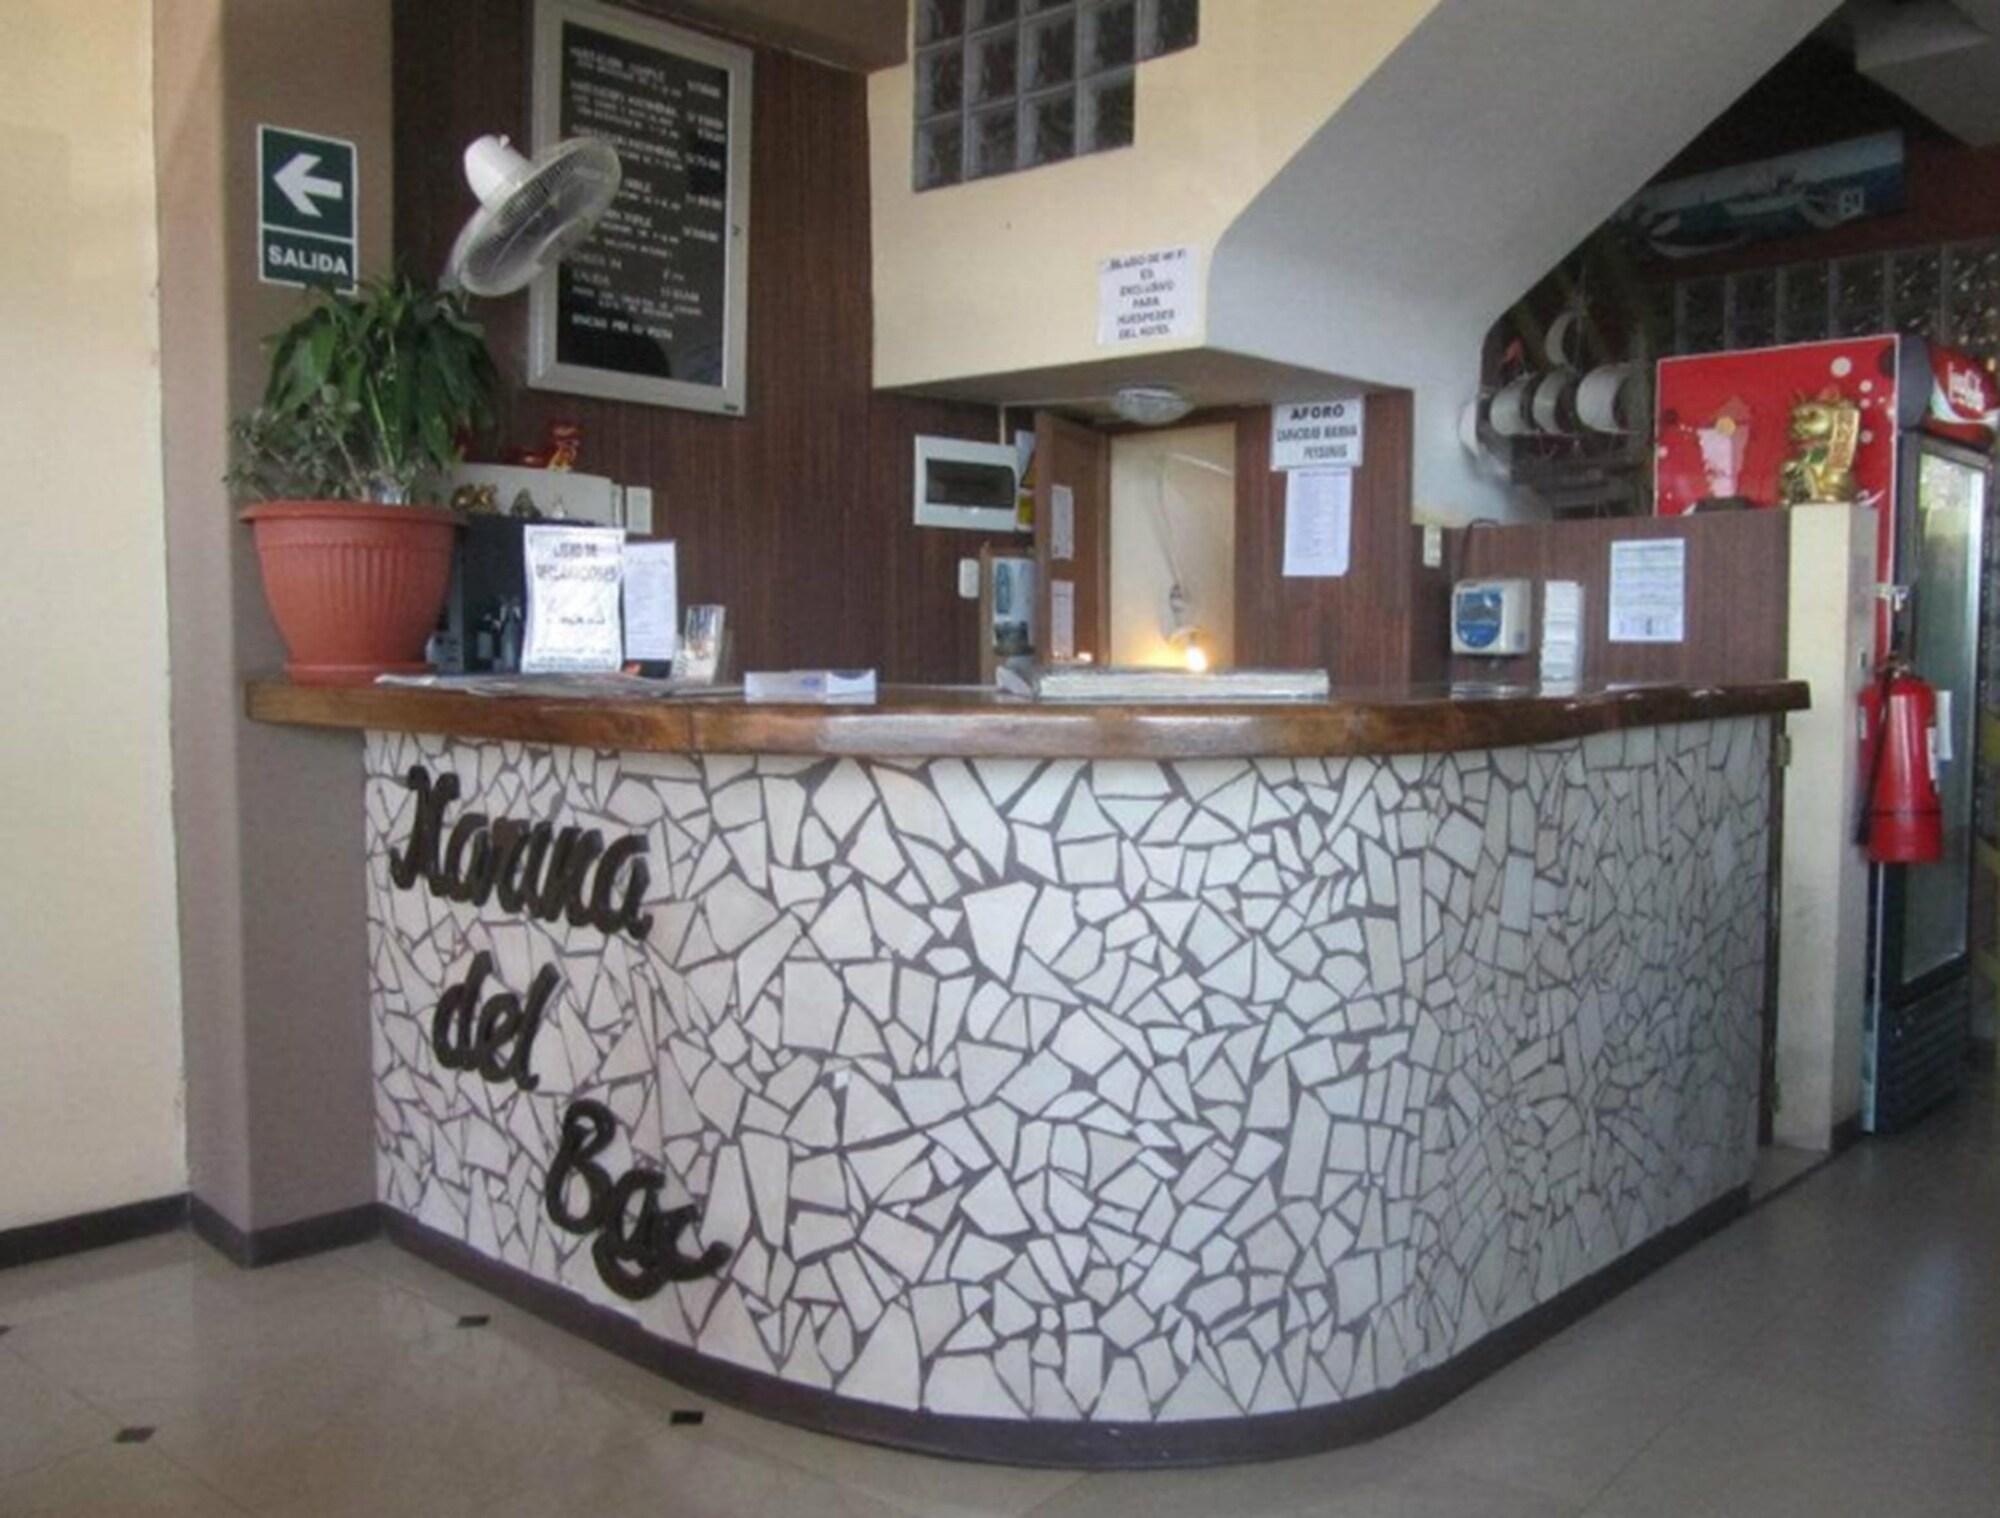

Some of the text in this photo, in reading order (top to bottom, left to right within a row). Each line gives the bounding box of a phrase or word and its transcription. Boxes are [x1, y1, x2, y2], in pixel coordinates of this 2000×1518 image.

[268, 245, 348, 276] SALIDA
[1290, 403, 1345, 421] AFORO
[432, 949, 562, 1093] del
